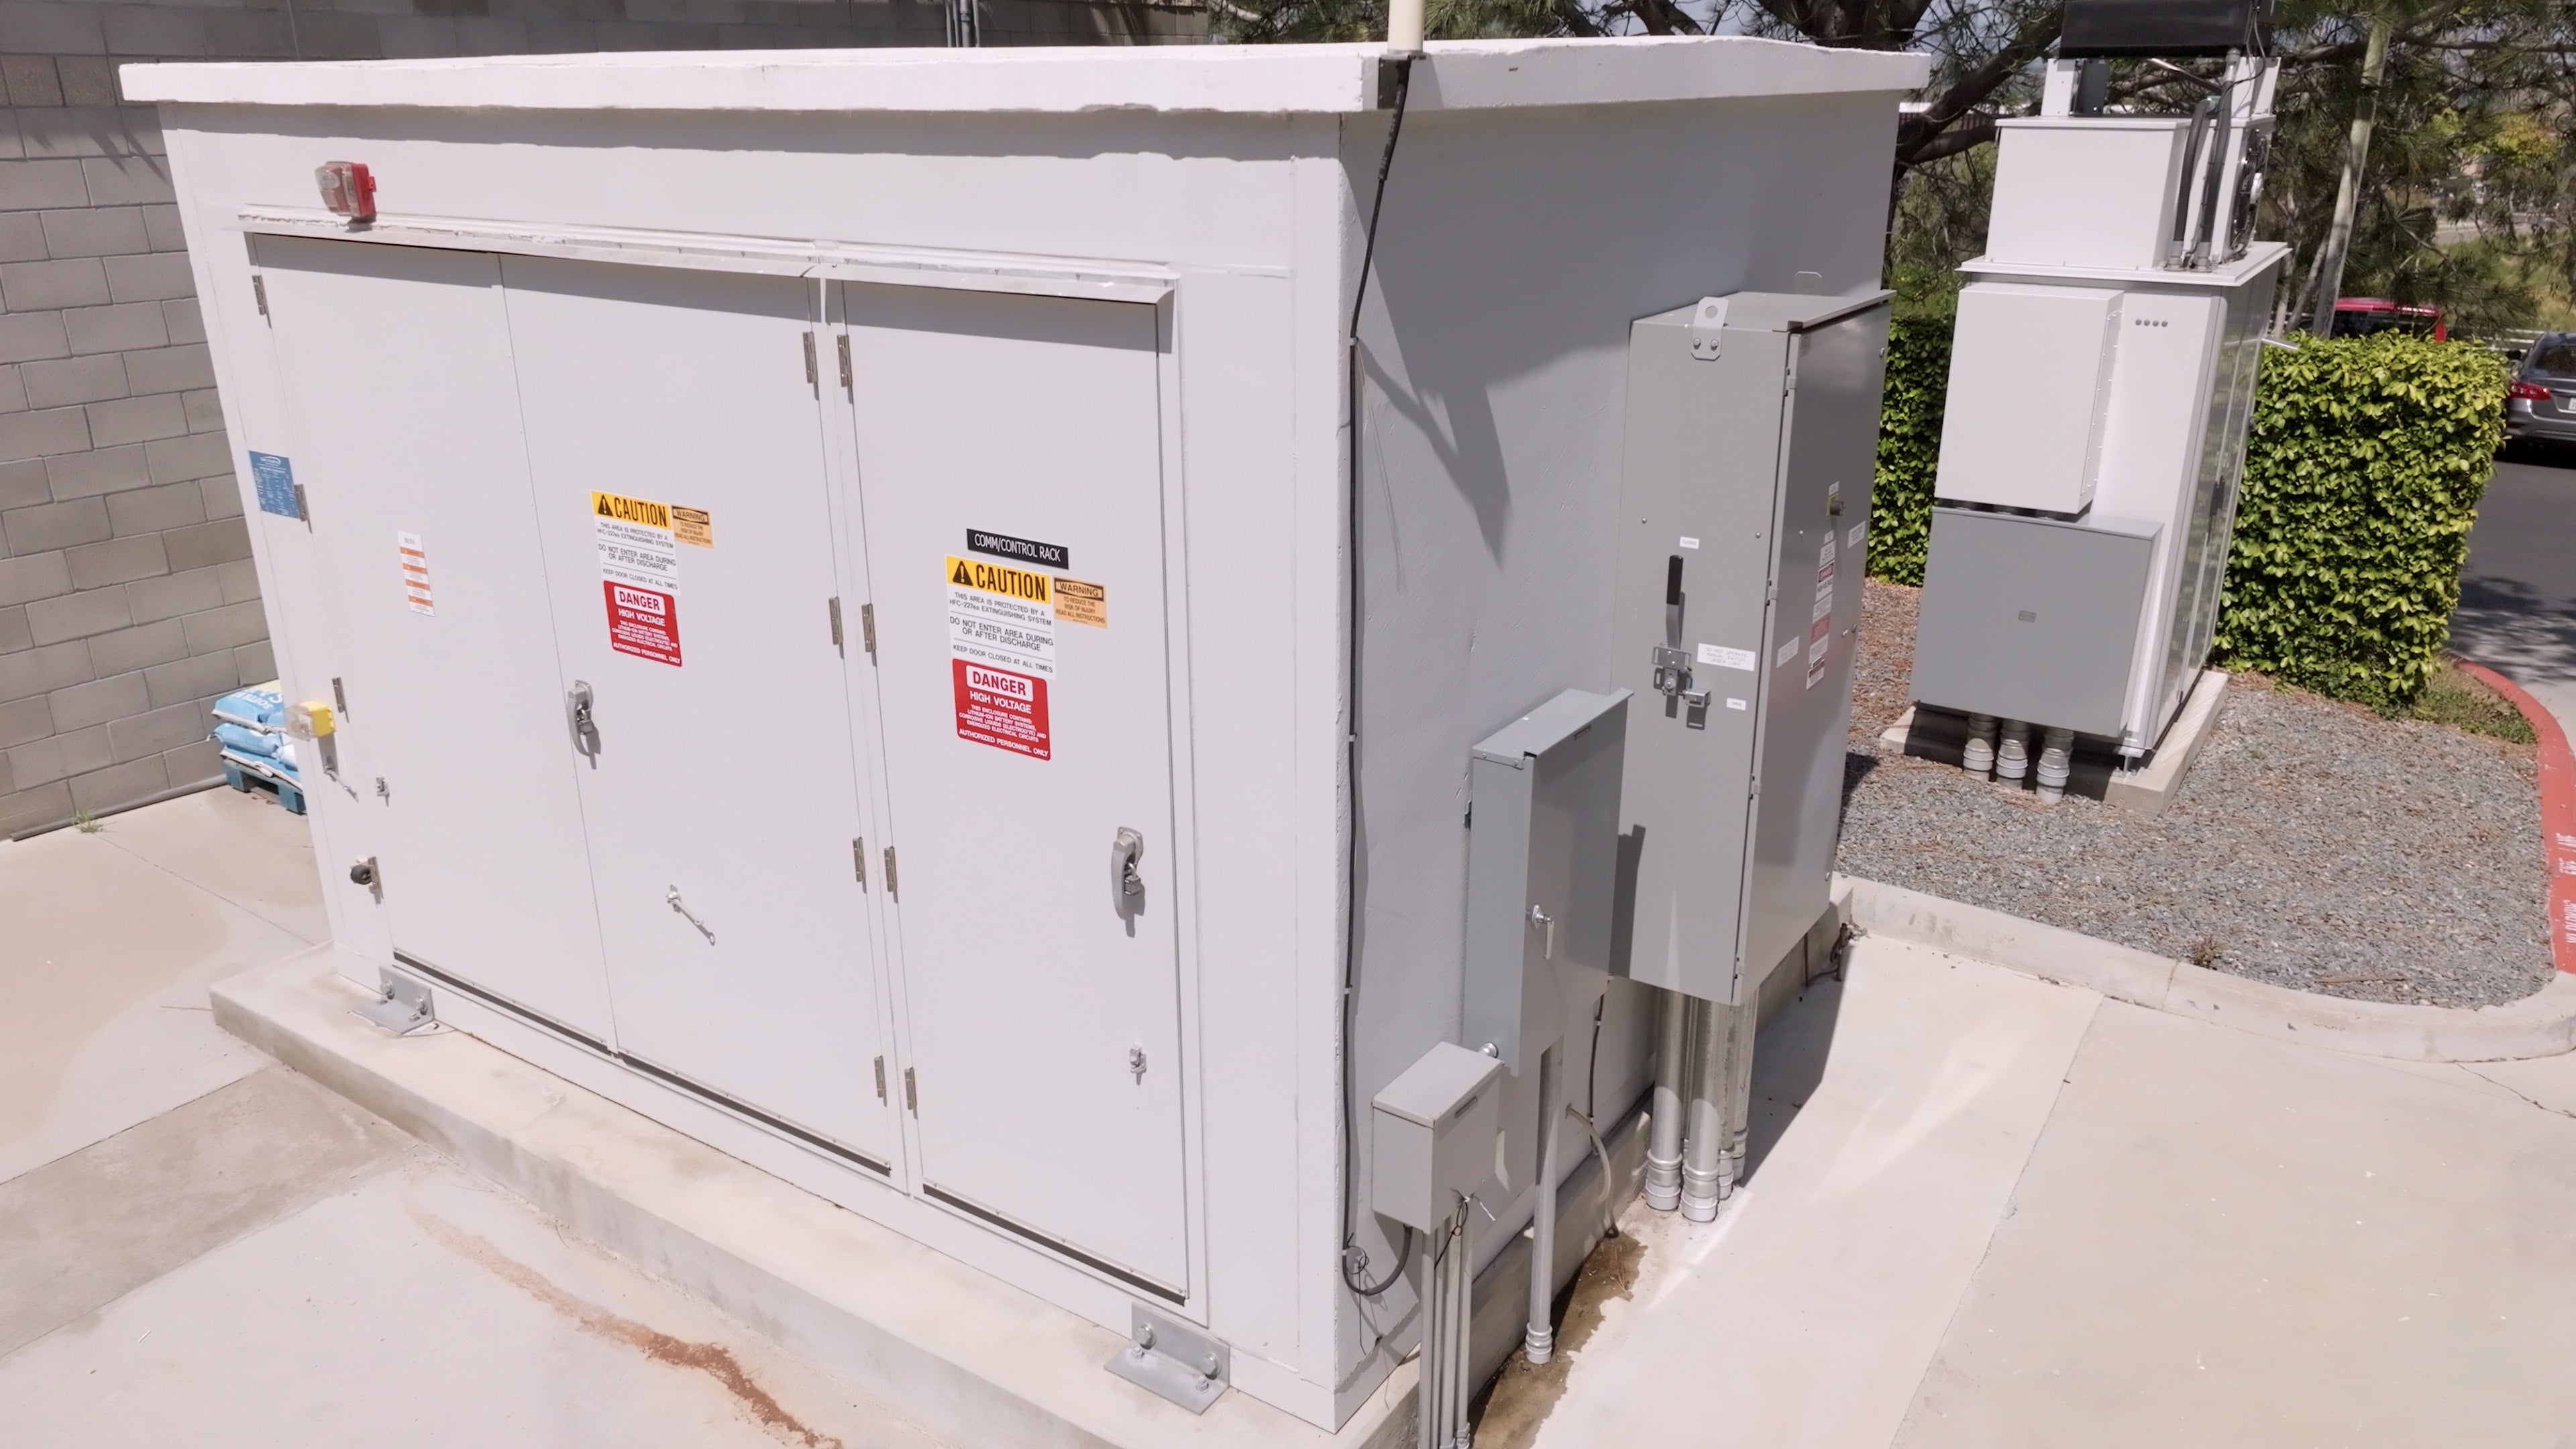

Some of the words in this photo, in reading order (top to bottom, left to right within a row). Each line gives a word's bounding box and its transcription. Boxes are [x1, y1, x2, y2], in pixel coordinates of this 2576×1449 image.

[614, 497, 667, 527] CAUTION
[676, 510, 704, 521] WARNING
[621, 533, 654, 545] EXTINGUISHING
[655, 540, 674, 548] SYSTEM
[631, 529, 655, 538] PROTECTED
[975, 533, 1038, 558] COMM/CONTROL
[1040, 547, 1061, 562] RACK
[619, 555, 635, 564] AFTER
[637, 559, 667, 571] DISCHARGE
[621, 549, 637, 557] ENTER
[640, 553, 653, 561] AREA
[655, 556, 676, 566] DURING
[629, 574, 647, 582] CLOSED
[665, 582, 678, 590] TIMES
[976, 565, 1045, 601] CAUTION
[1060, 582, 1098, 596] WARNING
[619, 591, 660, 610] DANGER
[995, 601, 1028, 612] PROTECTED
[1070, 598, 1086, 606] REDUCE
[618, 608, 635, 619] HIGH
[635, 612, 665, 627] VOLTAGE
[950, 599, 979, 610] HFC-227ea
[981, 606, 1025, 621] EXTINGUISHING
[1028, 616, 1051, 625] SYSTEM
[1076, 613, 1105, 623] INSTRUCTIONS
[950, 616, 960, 625] DO
[963, 620, 975, 628] NOT
[979, 623, 1001, 634] ENTER
[1005, 629, 1023, 639] AREA
[1026, 633, 1053, 645] DURING
[975, 631, 997, 641] AFTER
[1000, 636, 1041, 651] DISCHARGE
[969, 649, 985, 657] DOOR
[988, 653, 1011, 663] CLOSED
[1035, 663, 1053, 672] TIMES
[973, 671, 1026, 696] DANGER
[969, 691, 990, 703] HIGH
[994, 696, 1032, 714] VOLTAGE
[982, 708, 1008, 718] ENCLOSURE
[959, 729, 995, 743] AUTHORIZED
[997, 739, 1032, 753] PERSONNEL
[1033, 748, 1048, 757] ONLY
[991, 725, 1017, 737] ELECTRICAL
[1018, 733, 1039, 743] CIRCUITS
